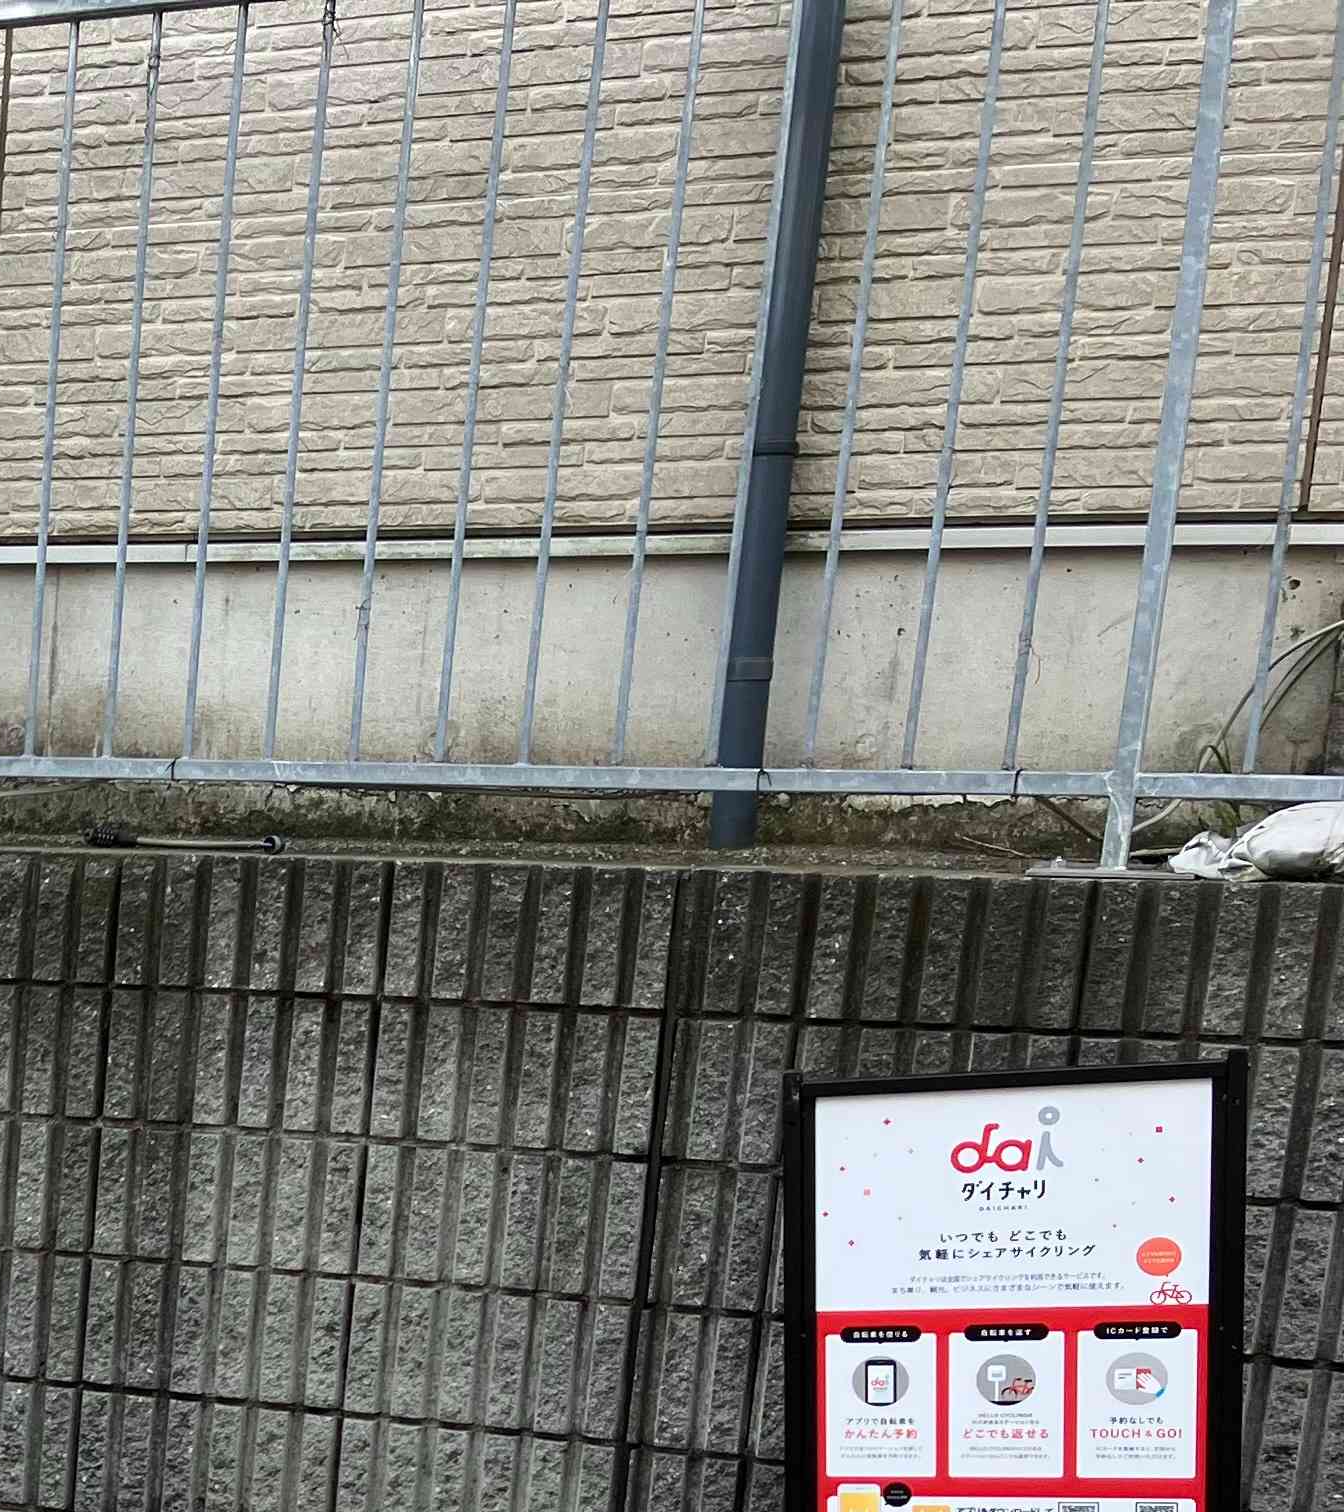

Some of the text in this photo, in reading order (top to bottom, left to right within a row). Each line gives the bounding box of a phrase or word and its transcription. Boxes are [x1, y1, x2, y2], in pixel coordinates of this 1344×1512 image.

[961, 1180, 1046, 1202] ダイチャリ
[940, 1229, 1067, 1243] いつでも どこでも
[918, 1244, 1096, 1261] 気軽にシェアサイクリング
[1109, 1415, 1164, 1425] 予約なしでも
[844, 1428, 919, 1440] かんたん予約
[962, 1427, 1050, 1440] どこでも返せる
[1089, 1427, 1141, 1439] TOUCH
[1156, 1427, 1183, 1439] GO!
